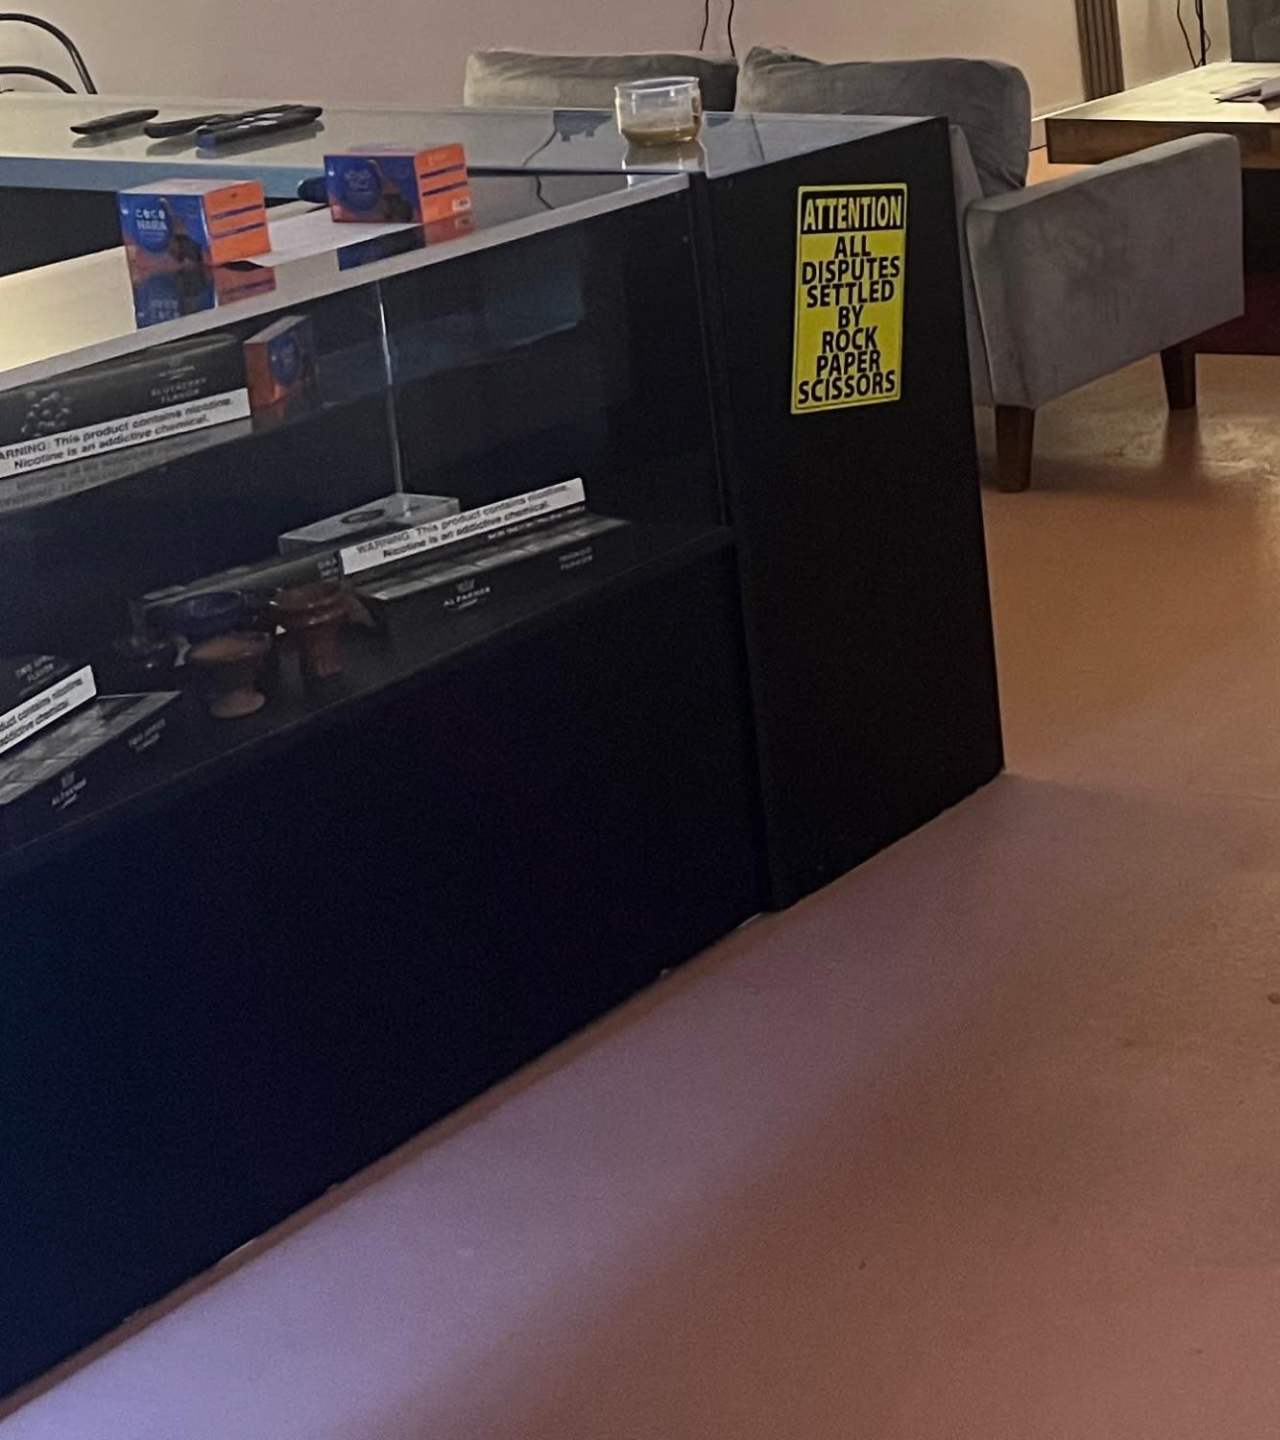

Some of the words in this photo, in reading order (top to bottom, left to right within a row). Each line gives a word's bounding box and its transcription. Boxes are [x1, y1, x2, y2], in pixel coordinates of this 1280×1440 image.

[803, 195, 902, 231] ATTENTION
[834, 235, 871, 260] ALL
[802, 256, 900, 285] DISPUTES
[806, 280, 894, 308] SETTLED
[838, 305, 864, 329] BY
[822, 326, 878, 353] ROCK
[816, 350, 881, 378] PAPER
[798, 370, 896, 404] SCISSORS
[54, 435, 80, 447] This
[83, 422, 129, 442] product
[132, 410, 182, 428] contains
[14, 451, 64, 469] Nicotine
[67, 447, 77, 457] is
[81, 443, 96, 453] an
[99, 430, 152, 449] addictive
[415, 522, 438, 536] This
[441, 510, 480, 530] product
[482, 498, 526, 515] contains
[456, 517, 502, 536] addictive
